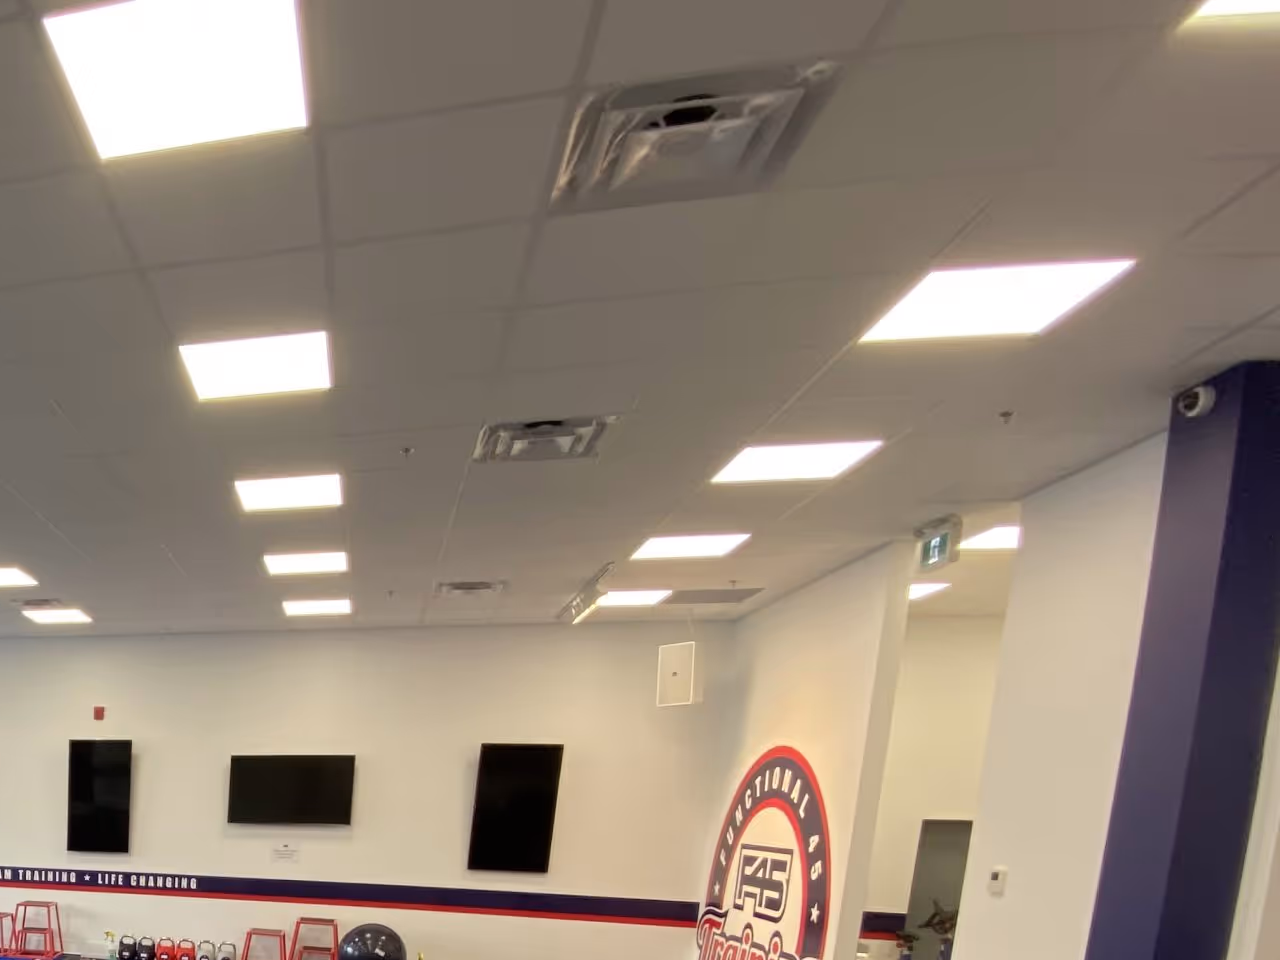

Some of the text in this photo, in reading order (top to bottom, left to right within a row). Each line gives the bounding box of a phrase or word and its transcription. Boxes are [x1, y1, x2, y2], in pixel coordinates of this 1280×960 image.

[720, 766, 822, 880] FUNCTIONAL 45
[18, 869, 77, 884] TRAINING
[97, 872, 124, 886] LIFE
[130, 874, 198, 890] CHANGING
[734, 843, 794, 923] F45
